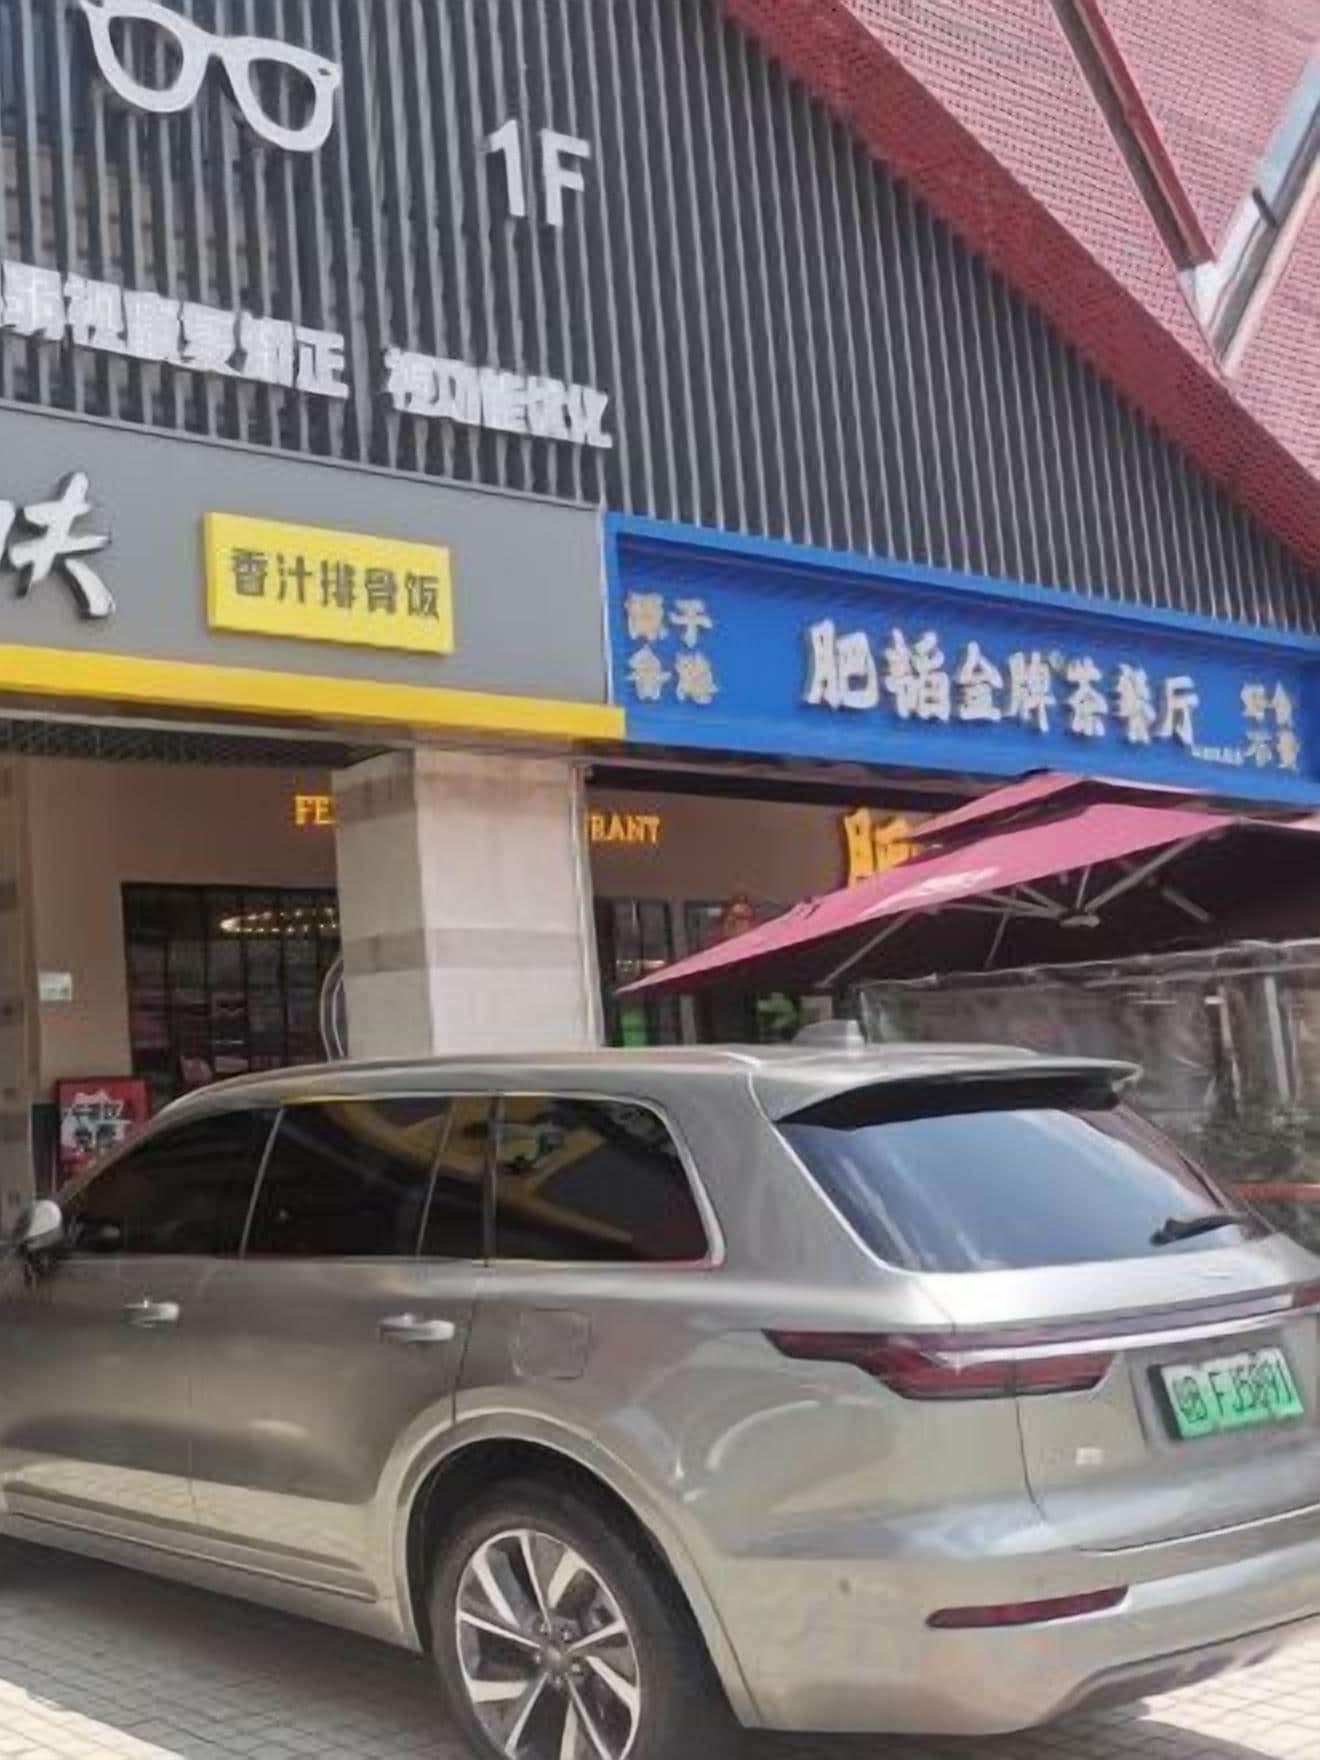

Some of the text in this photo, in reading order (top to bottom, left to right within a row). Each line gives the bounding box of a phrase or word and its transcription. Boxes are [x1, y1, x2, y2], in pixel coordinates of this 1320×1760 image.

[489, 119, 591, 228] 1F
[231, 547, 440, 623] 香汁排骨饭
